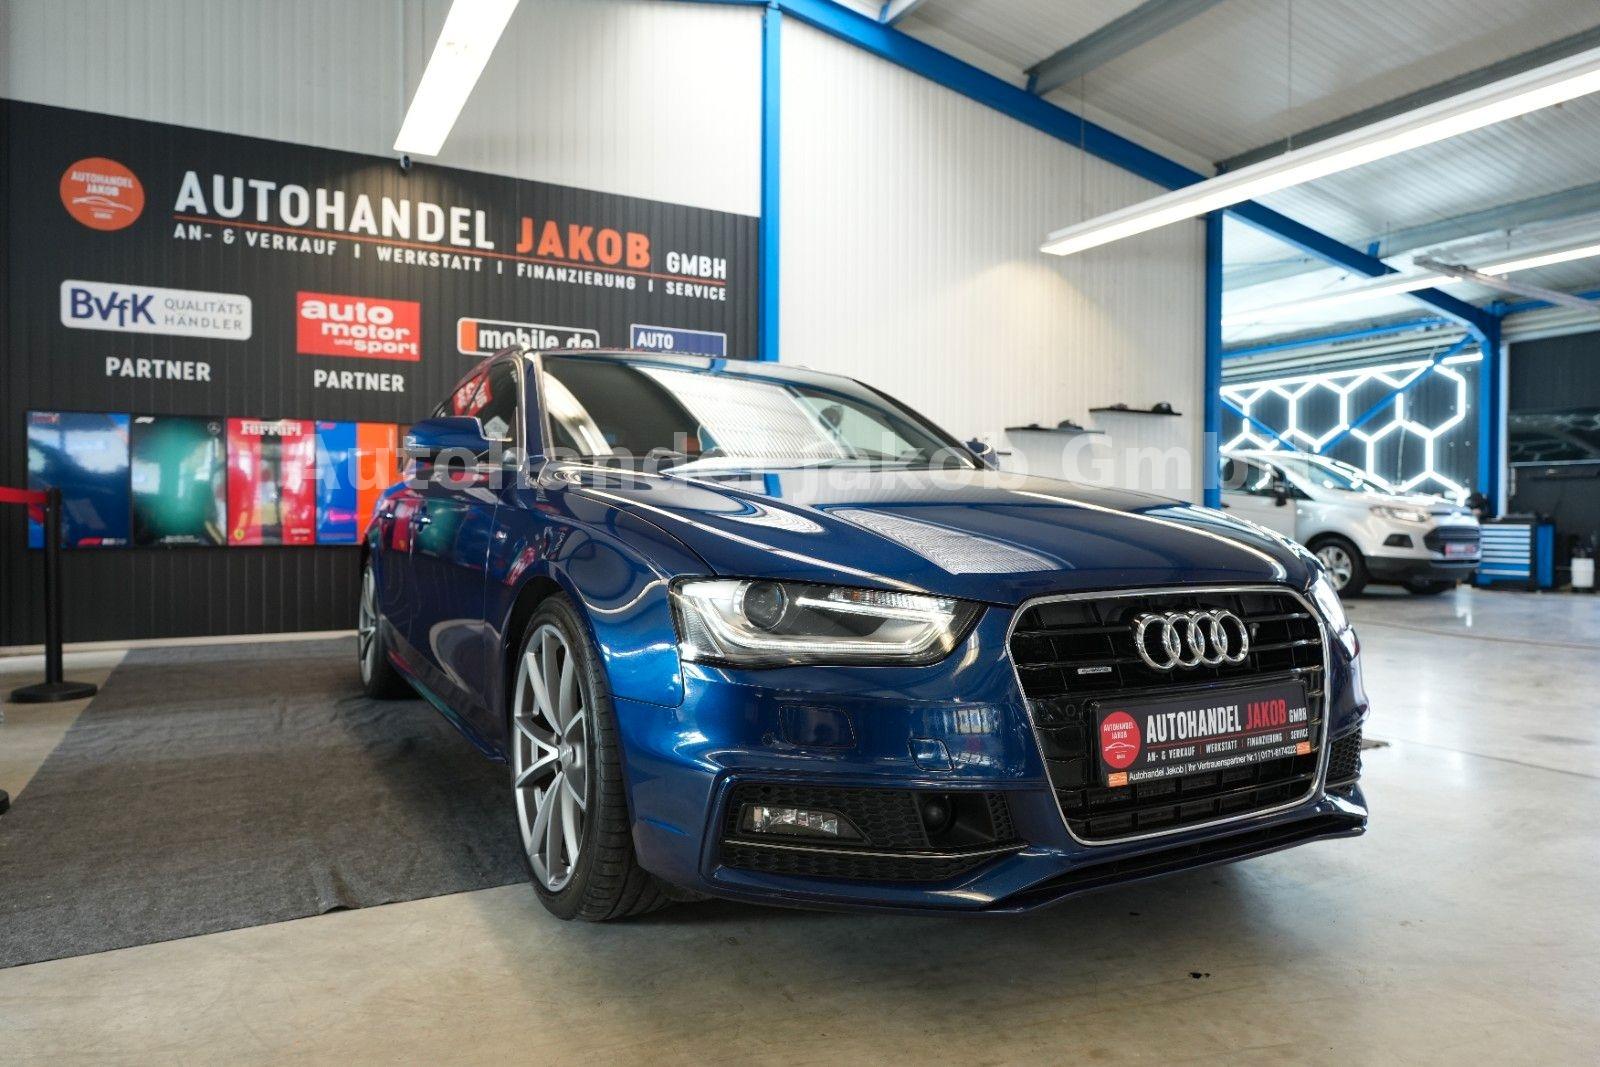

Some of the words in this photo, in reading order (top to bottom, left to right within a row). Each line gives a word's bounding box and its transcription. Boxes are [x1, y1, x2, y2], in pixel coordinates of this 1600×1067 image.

[174, 170, 495, 250] AUTOHANDEL
[516, 217, 651, 269] JAKOB
[666, 251, 727, 280] GMBH
[173, 223, 213, 241] AN-
[222, 229, 236, 245] &
[245, 230, 338, 256] VERKAUF
[376, 244, 483, 273] WERKSTATT
[517, 262, 637, 291] FINANZIERUNG
[665, 281, 727, 301] SERVICE
[70, 287, 156, 327] BVfK
[300, 299, 395, 326] auto
[321, 321, 411, 342] motor
[636, 331, 674, 350] AUTO
[353, 339, 419, 356] sport
[105, 356, 212, 382] PARTNER
[313, 368, 405, 393] PARTNER
[1146, 705, 1242, 743] AUTOHANDEL
[1245, 699, 1287, 730] JAKOB
[1288, 707, 1308, 723] GMBH
[1168, 746, 1195, 760] VERKAUF
[1205, 740, 1238, 754] WERKSTATT
[1129, 767, 1165, 781] Autohandel
[1165, 765, 1184, 776] Jakob
